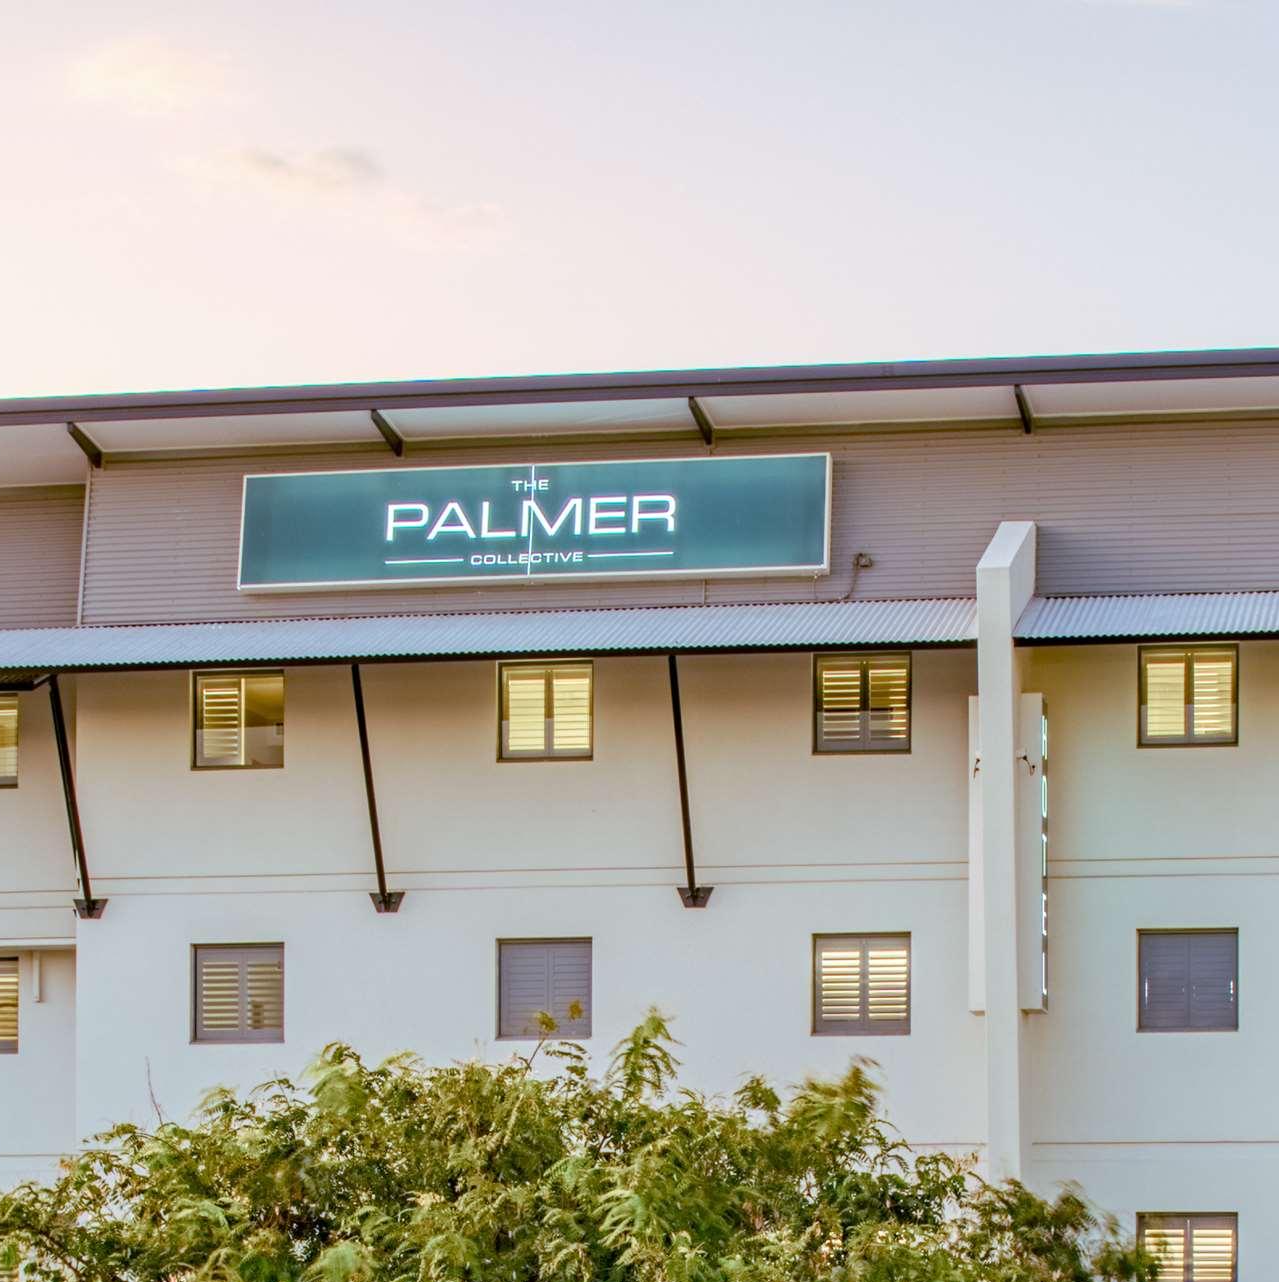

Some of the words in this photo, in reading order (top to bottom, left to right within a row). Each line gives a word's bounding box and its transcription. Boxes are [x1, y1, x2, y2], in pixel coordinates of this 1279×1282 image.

[511, 479, 549, 492] THE
[385, 494, 677, 542] PALMER
[470, 551, 584, 566] COLLECTIVE
